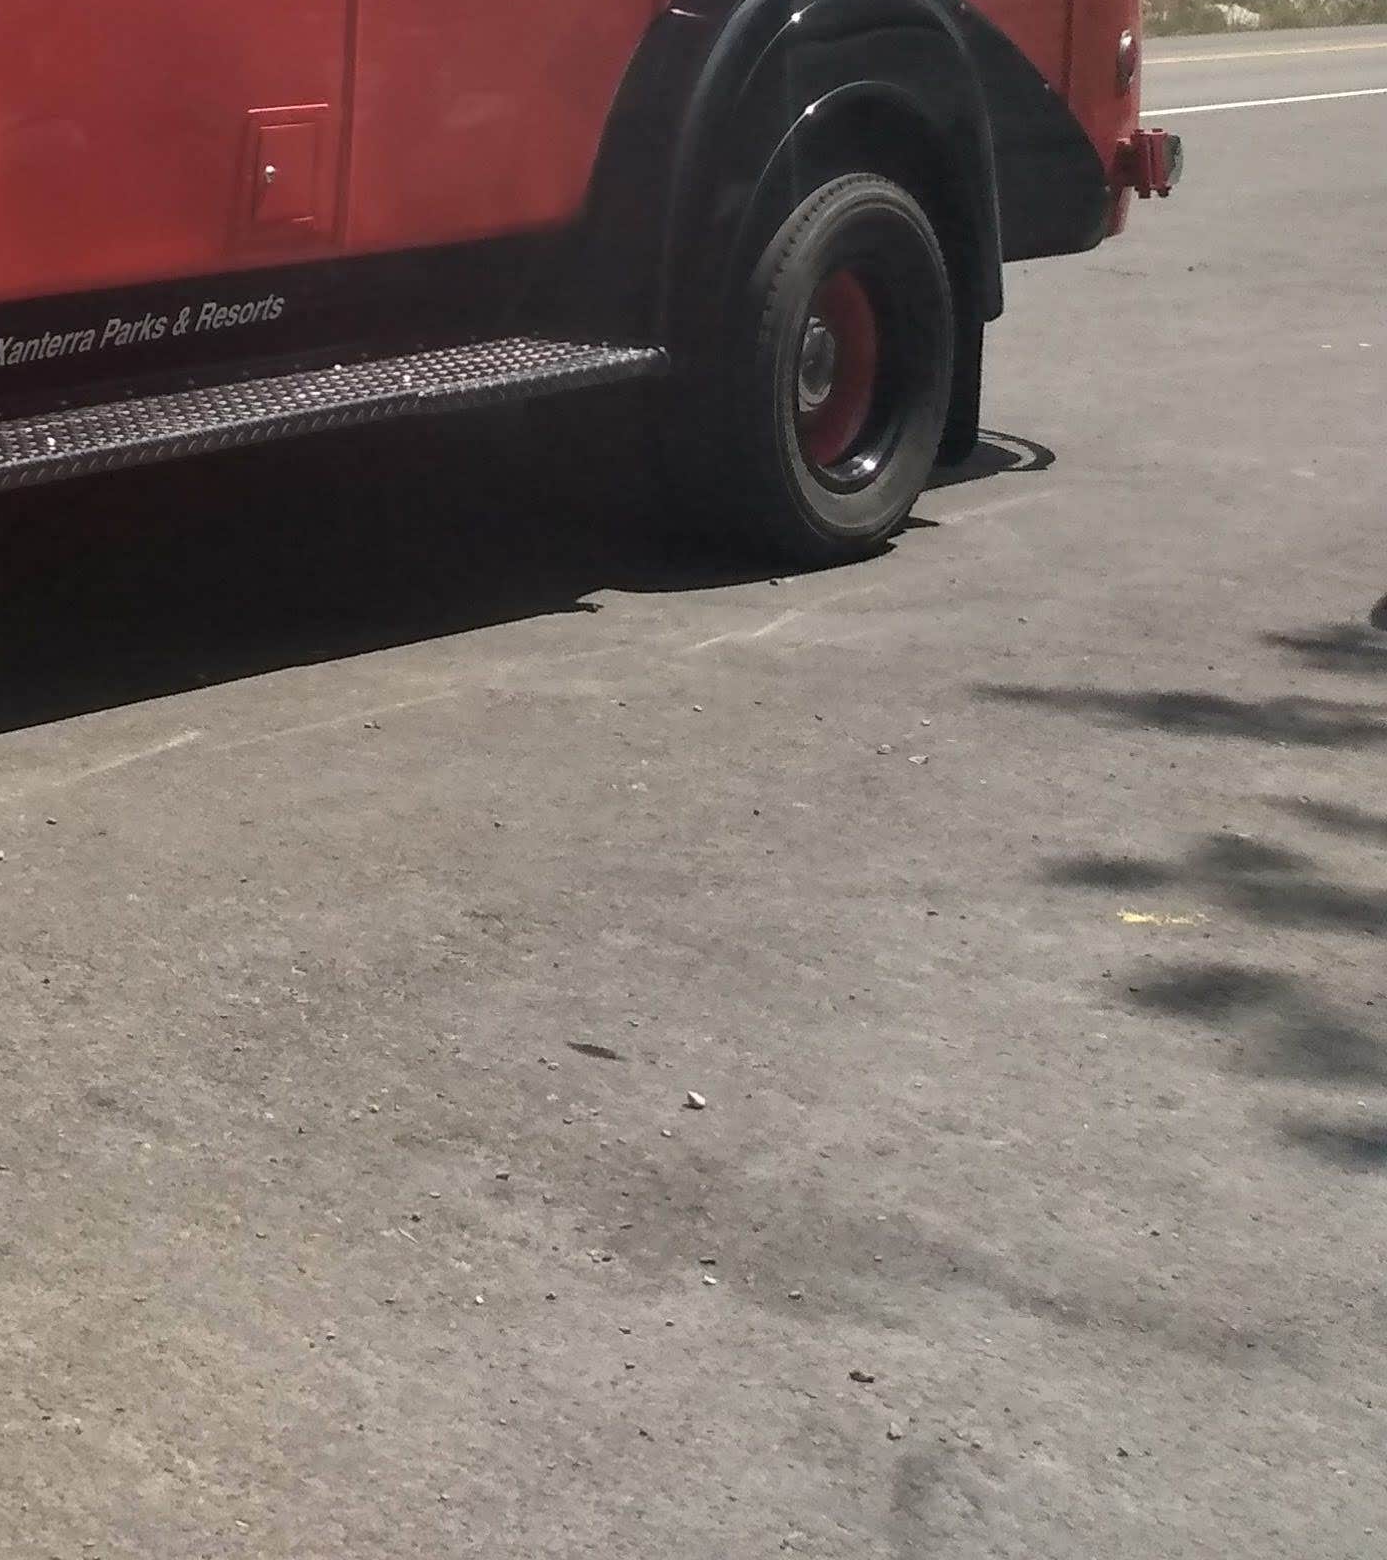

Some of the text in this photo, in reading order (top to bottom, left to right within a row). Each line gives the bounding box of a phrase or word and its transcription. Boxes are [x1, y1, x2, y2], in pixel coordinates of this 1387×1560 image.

[99, 312, 168, 349] Parks
[171, 306, 191, 336] &
[195, 293, 285, 332] Resorts
